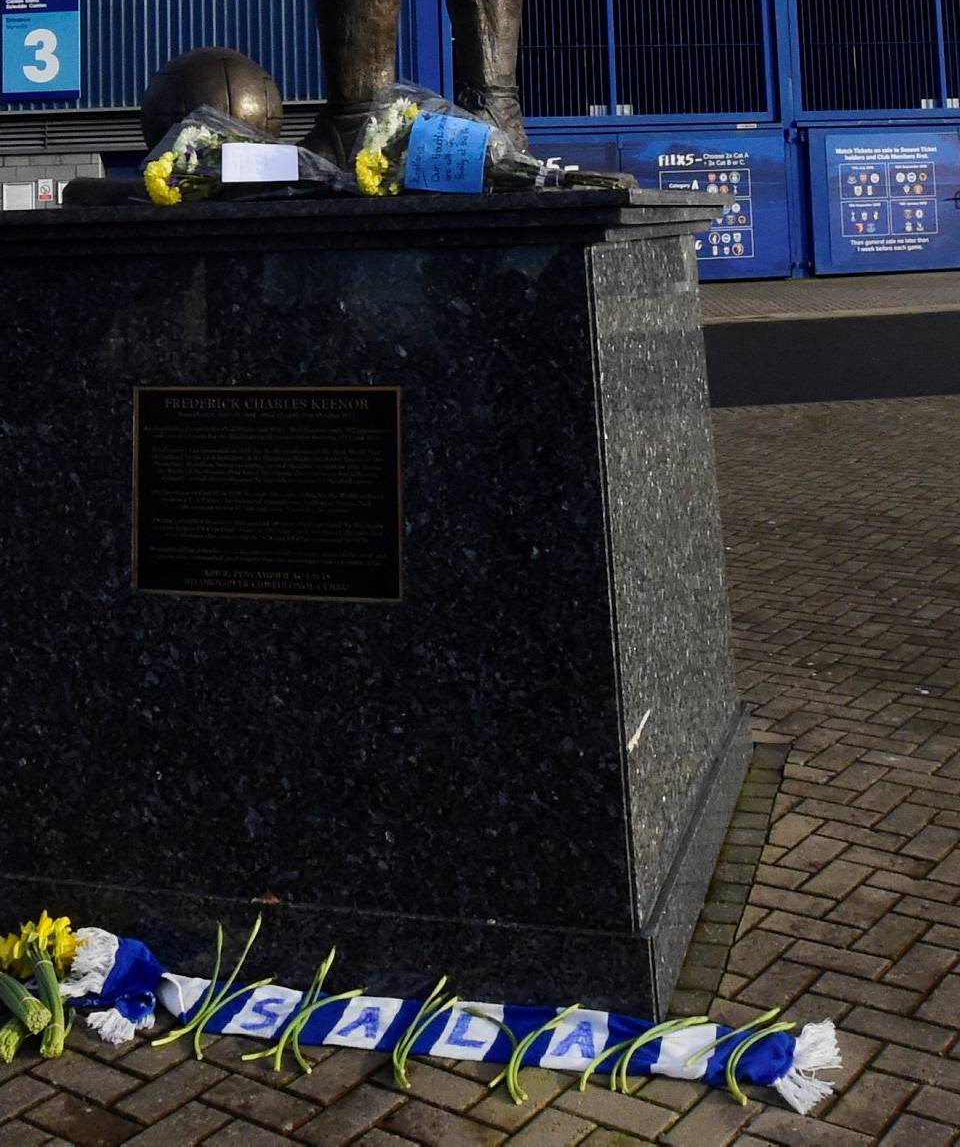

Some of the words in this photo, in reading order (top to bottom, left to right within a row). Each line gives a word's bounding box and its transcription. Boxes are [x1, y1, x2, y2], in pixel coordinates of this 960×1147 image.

[23, 28, 59, 83] 3
[691, 179, 700, 190] A
[164, 398, 241, 410] FREDERICK
[244, 398, 307, 411] CHARLES
[311, 398, 369, 411] KEENOR
